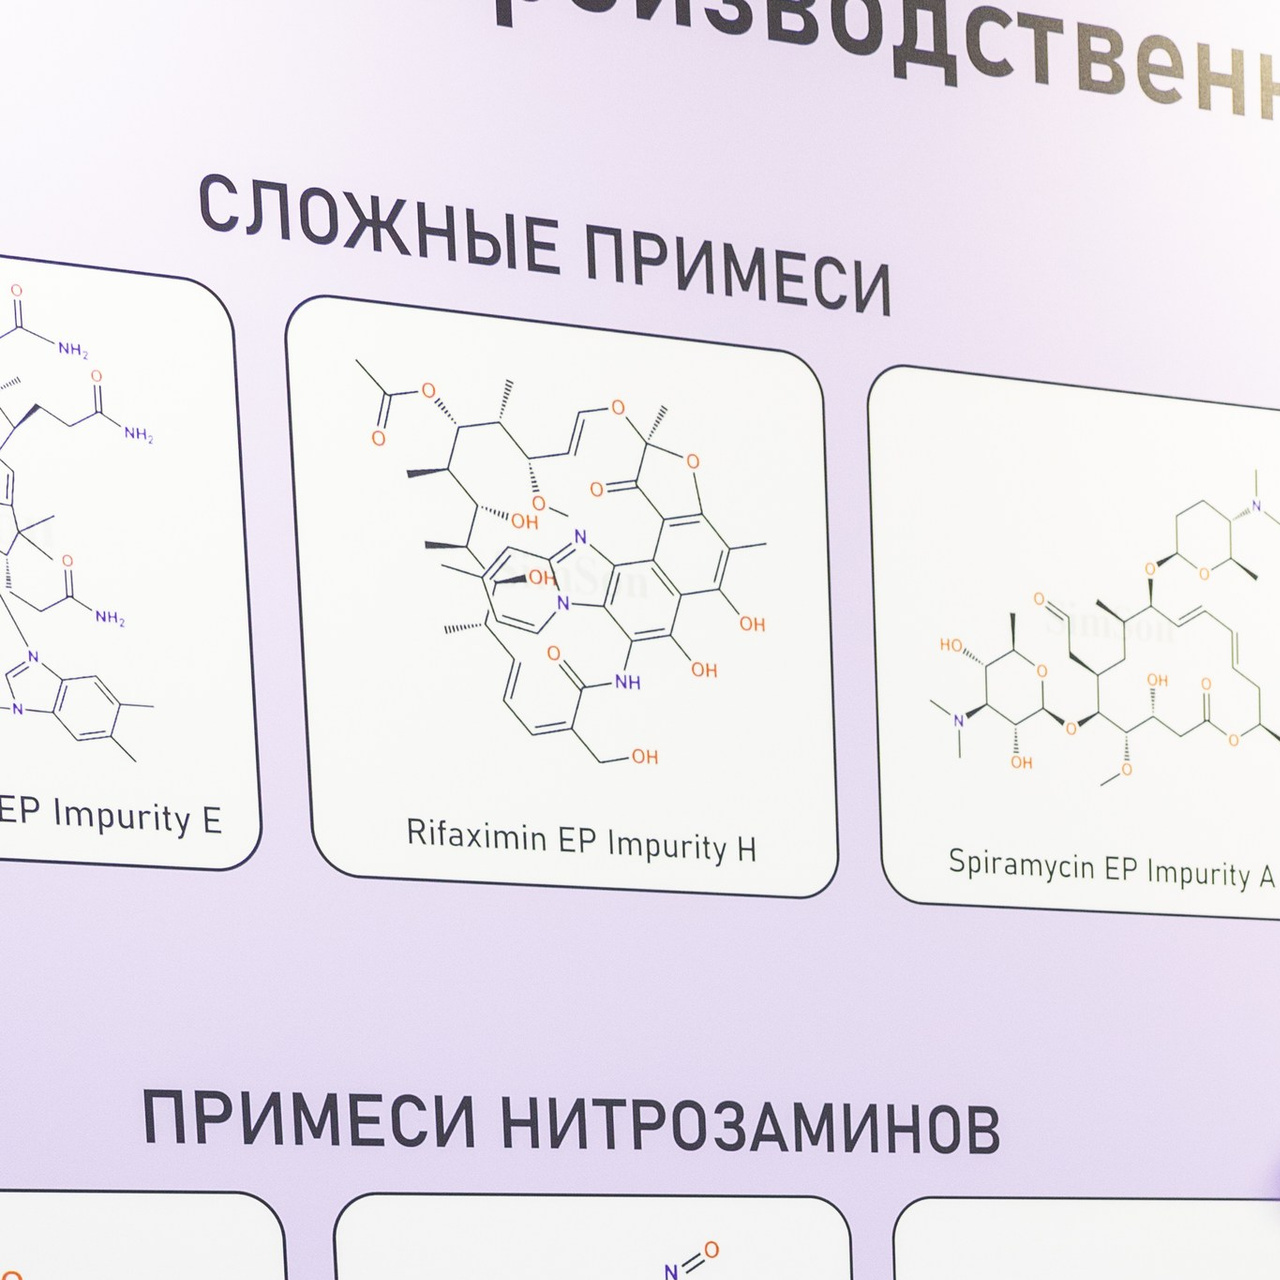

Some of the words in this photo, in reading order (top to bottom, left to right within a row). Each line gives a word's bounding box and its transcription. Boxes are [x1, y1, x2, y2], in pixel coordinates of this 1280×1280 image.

[199, 173, 562, 275] СЛОЖНЫЕ
[586, 224, 890, 316] ПРИМЕСИ
[11, 284, 23, 296] O
[91, 370, 103, 382] O
[422, 383, 436, 398] O
[612, 399, 625, 414] O
[372, 431, 385, 446] O
[687, 454, 700, 468] O
[590, 482, 603, 497] O
[532, 495, 546, 510] O
[1252, 500, 1261, 512] N
[511, 513, 538, 529] OH
[575, 529, 586, 544] N
[62, 554, 74, 567] O
[1145, 562, 1156, 576] O
[1199, 567, 1210, 581] O
[529, 570, 555, 585] OH
[558, 595, 569, 610] N
[1033, 591, 1045, 606] O
[740, 616, 765, 631] OH
[547, 645, 560, 660] O
[940, 637, 963, 653] HO
[28, 650, 38, 662] N
[691, 662, 717, 677] OH
[1036, 664, 1048, 678] O
[616, 674, 640, 689] NH
[1147, 672, 1168, 687] OH
[1201, 677, 1212, 691] O
[13, 703, 23, 715] N
[954, 714, 963, 726] N
[1065, 722, 1077, 736] O
[1228, 734, 1240, 747] O
[632, 749, 658, 764] OH
[1010, 755, 1033, 770] OH
[1121, 762, 1133, 777] O
[0, 795, 40, 823] EP
[55, 798, 190, 839] Impurity
[204, 807, 221, 833] E
[408, 818, 546, 851] Rifaximin
[560, 827, 595, 852] EP
[607, 828, 727, 868] Impurity
[739, 837, 755, 861] H
[950, 848, 1093, 883] Spiramycin
[1106, 856, 1137, 880] EP
[1149, 859, 1250, 892] Impurity
[1260, 865, 1275, 887] A
[144, 1089, 474, 1147] ПРИМЕСИ
[502, 1097, 999, 1154] НИТРОЗАМИНОВ
[704, 1240, 720, 1259] O
[665, 1264, 678, 1280] N
